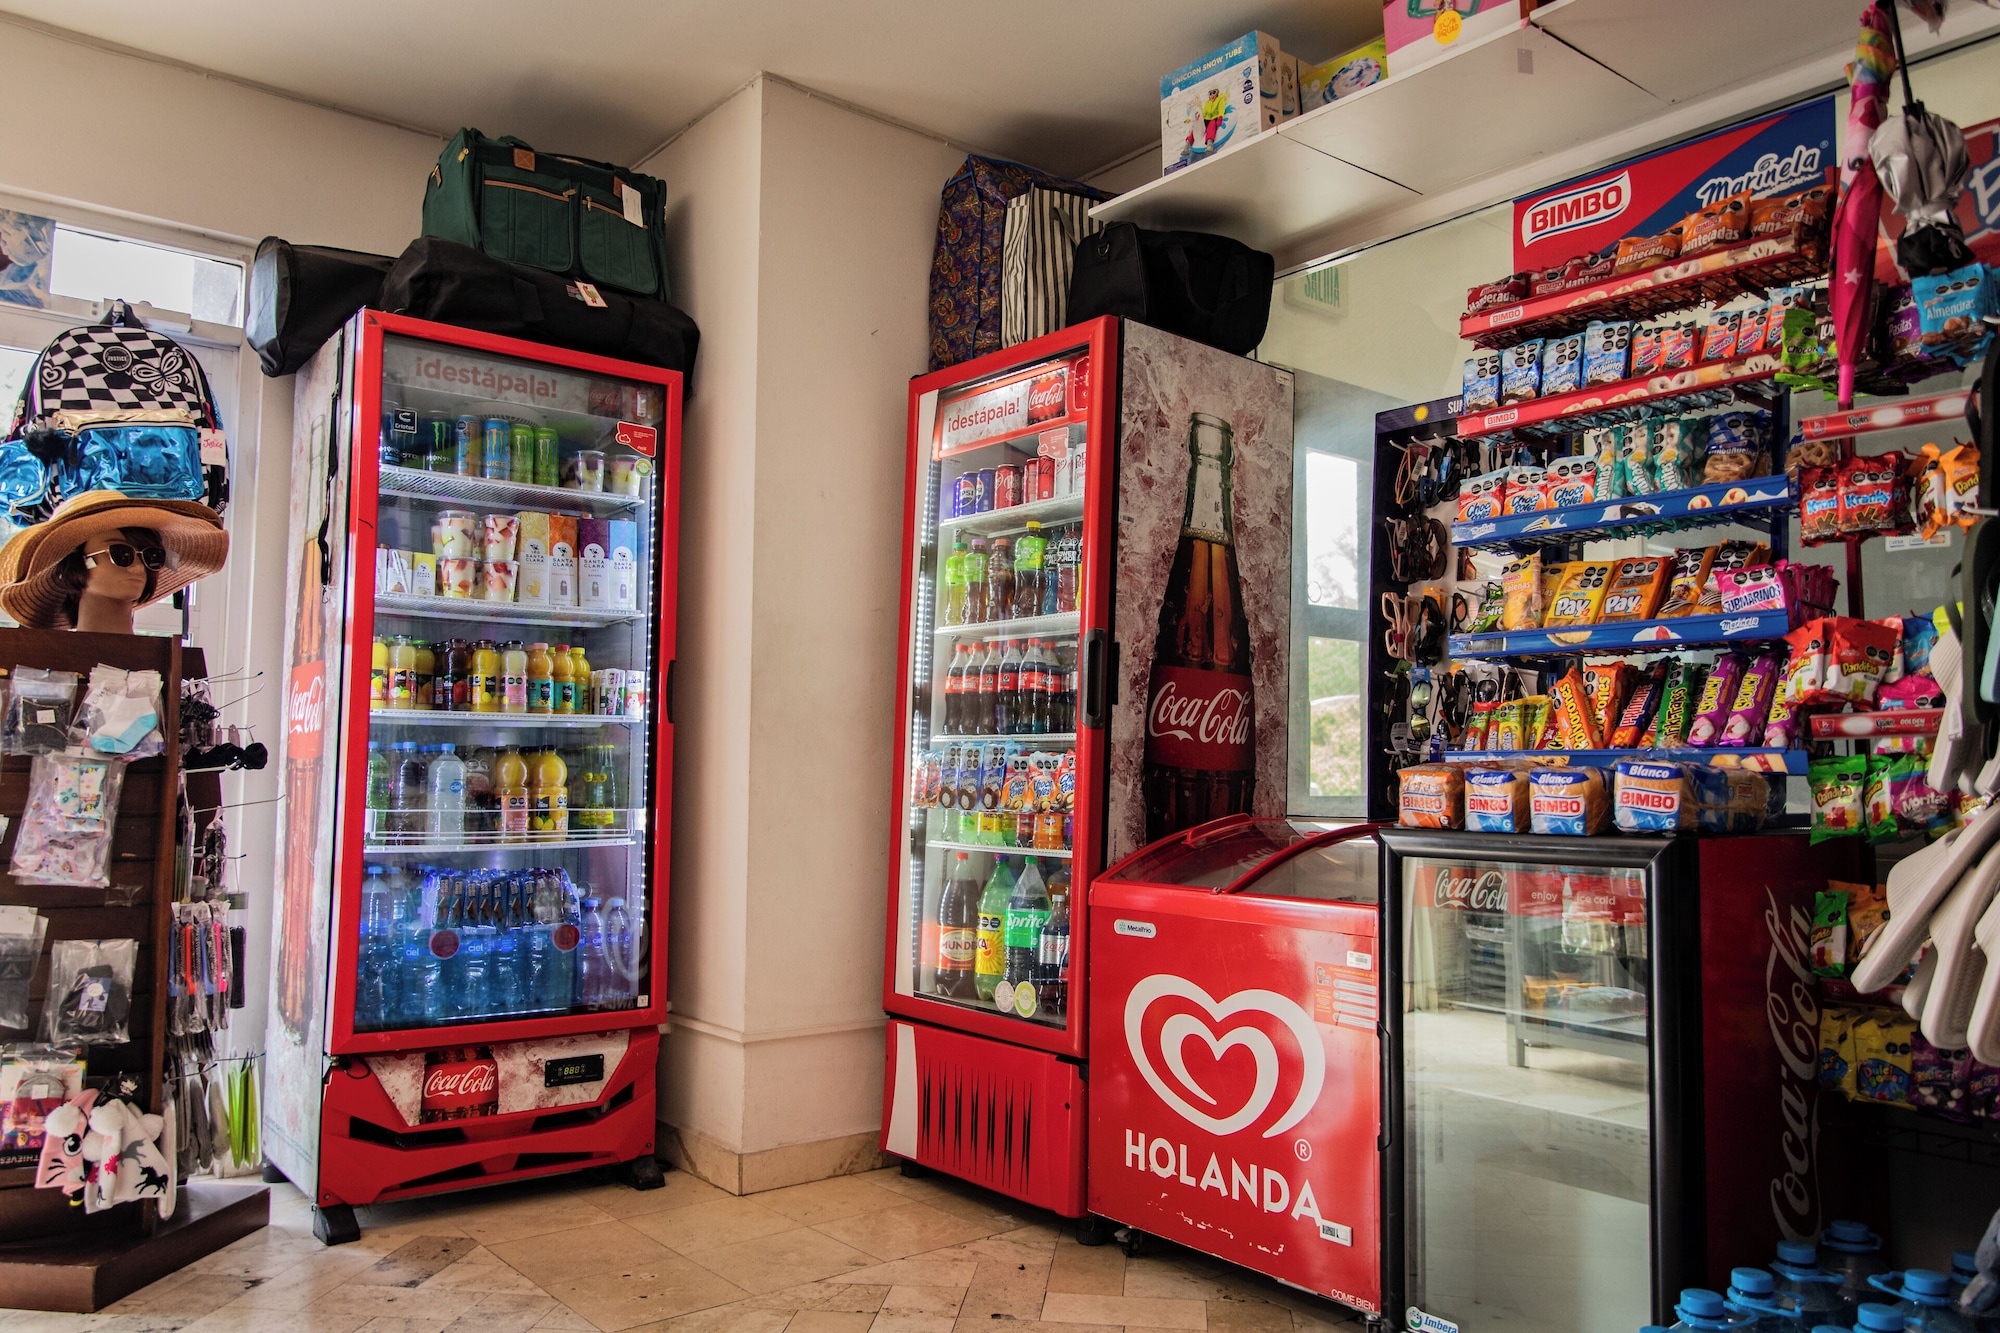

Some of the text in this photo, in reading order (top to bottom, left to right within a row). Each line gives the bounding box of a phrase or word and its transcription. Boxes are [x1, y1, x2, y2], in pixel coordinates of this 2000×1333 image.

[1172, 46, 1243, 86] UNICORN SNOW TUBE
[1696, 146, 1820, 206] Marinela
[1531, 185, 1622, 234] BIMBO
[1493, 310, 1521, 323] BIMBO
[1927, 298, 1976, 320] Almendras
[415, 356, 557, 399] ¡destápala!
[1029, 382, 1064, 411] Coca-Cola
[948, 397, 1020, 433] ¡destápala!
[1487, 412, 1516, 425] BIMBO
[1904, 405, 1930, 415] GOLDEN
[1511, 494, 1539, 506] Choco
[1554, 485, 1585, 501] Choco
[1846, 490, 1893, 508] Kranky
[1554, 597, 1591, 617] Pay
[1604, 595, 1642, 614] Pay
[1842, 662, 1879, 676] Panditas
[1150, 681, 1252, 745] Coca-Cola
[1900, 717, 1925, 725] GOLDEN
[1471, 774, 1503, 785] Blanco
[1539, 774, 1573, 785] Blanco
[1629, 765, 1670, 779] Blanco
[1402, 796, 1442, 810] BIMBO
[1469, 799, 1508, 812] BIMBO
[1534, 800, 1580, 813] BIMBO
[1620, 792, 1675, 810] BIMBO
[1434, 869, 1509, 912] Coca-Cola
[1531, 892, 1557, 902] enjoy
[1577, 893, 1616, 906] ice cold
[1007, 912, 1044, 930] Sprite
[405, 947, 420, 957] ciel
[468, 943, 483, 954] ciel
[1765, 884, 1821, 1247] Coca-Cola
[424, 1064, 497, 1099] Coca-Cola
[1125, 1128, 1323, 1227] HOLANDA
[1331, 1288, 1375, 1312] COME BIEN
[1424, 1316, 1457, 1333] Imbera
